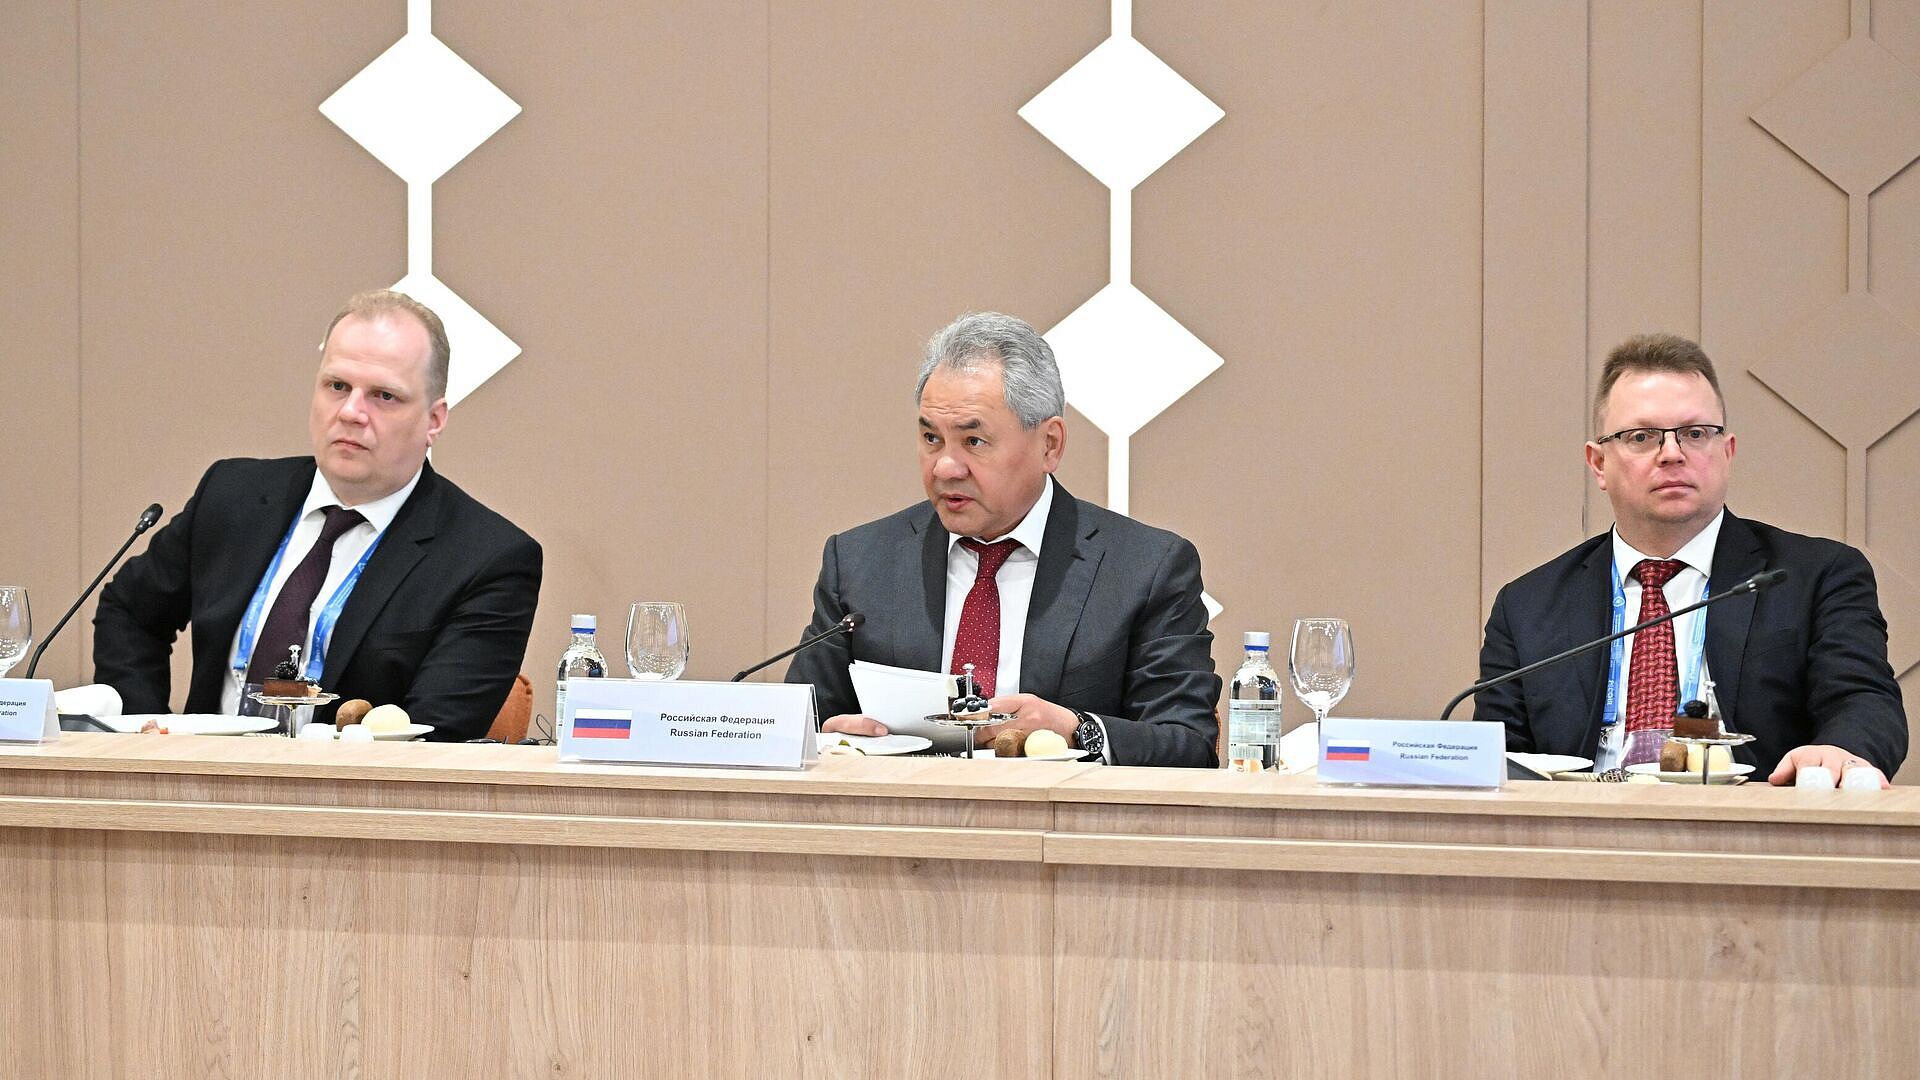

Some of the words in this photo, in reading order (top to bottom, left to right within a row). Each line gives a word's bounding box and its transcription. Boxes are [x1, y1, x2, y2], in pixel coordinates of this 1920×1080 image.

[660, 713, 717, 723] Российская
[720, 715, 775, 725] Федерация
[670, 728, 708, 738] Russian
[711, 730, 761, 740] Federation
[1392, 740, 1435, 749] Российская
[1437, 743, 1478, 751] Федерация
[1400, 752, 1429, 760] Russian
[1431, 753, 1469, 761] Federation
